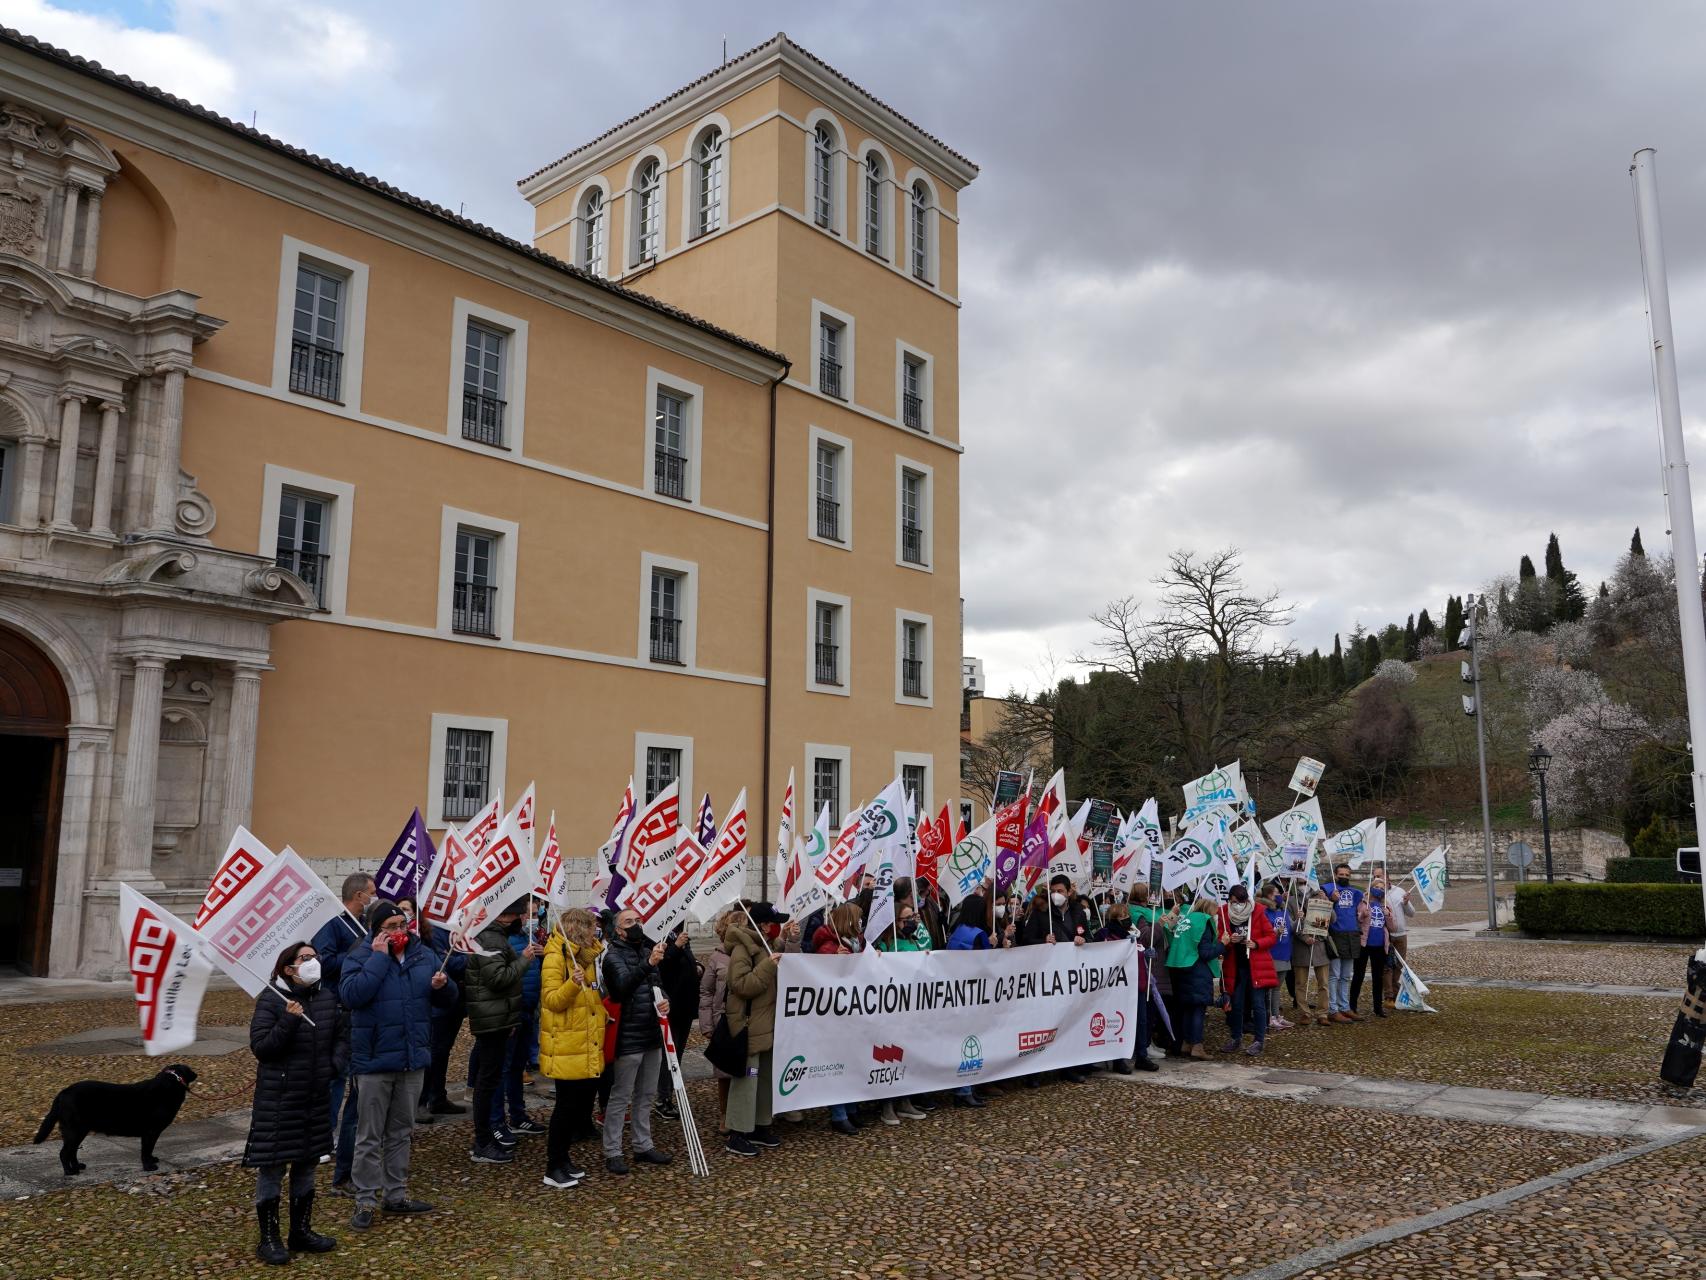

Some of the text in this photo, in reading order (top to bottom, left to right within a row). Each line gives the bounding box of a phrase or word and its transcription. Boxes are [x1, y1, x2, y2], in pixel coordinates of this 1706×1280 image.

[378, 827, 417, 897] CCO
[194, 855, 255, 926] CCOO
[482, 894, 497, 907] illa
[499, 875, 517, 894] León
[703, 864, 742, 897] Castilla y
[784, 963, 1128, 1017] EDUCACIÓN INFANTIL 0-3 EN LA PÚBLICA
[784, 1063, 845, 1083] CSIF EDUCACIÓN
[957, 1058, 984, 1072] ANPE
